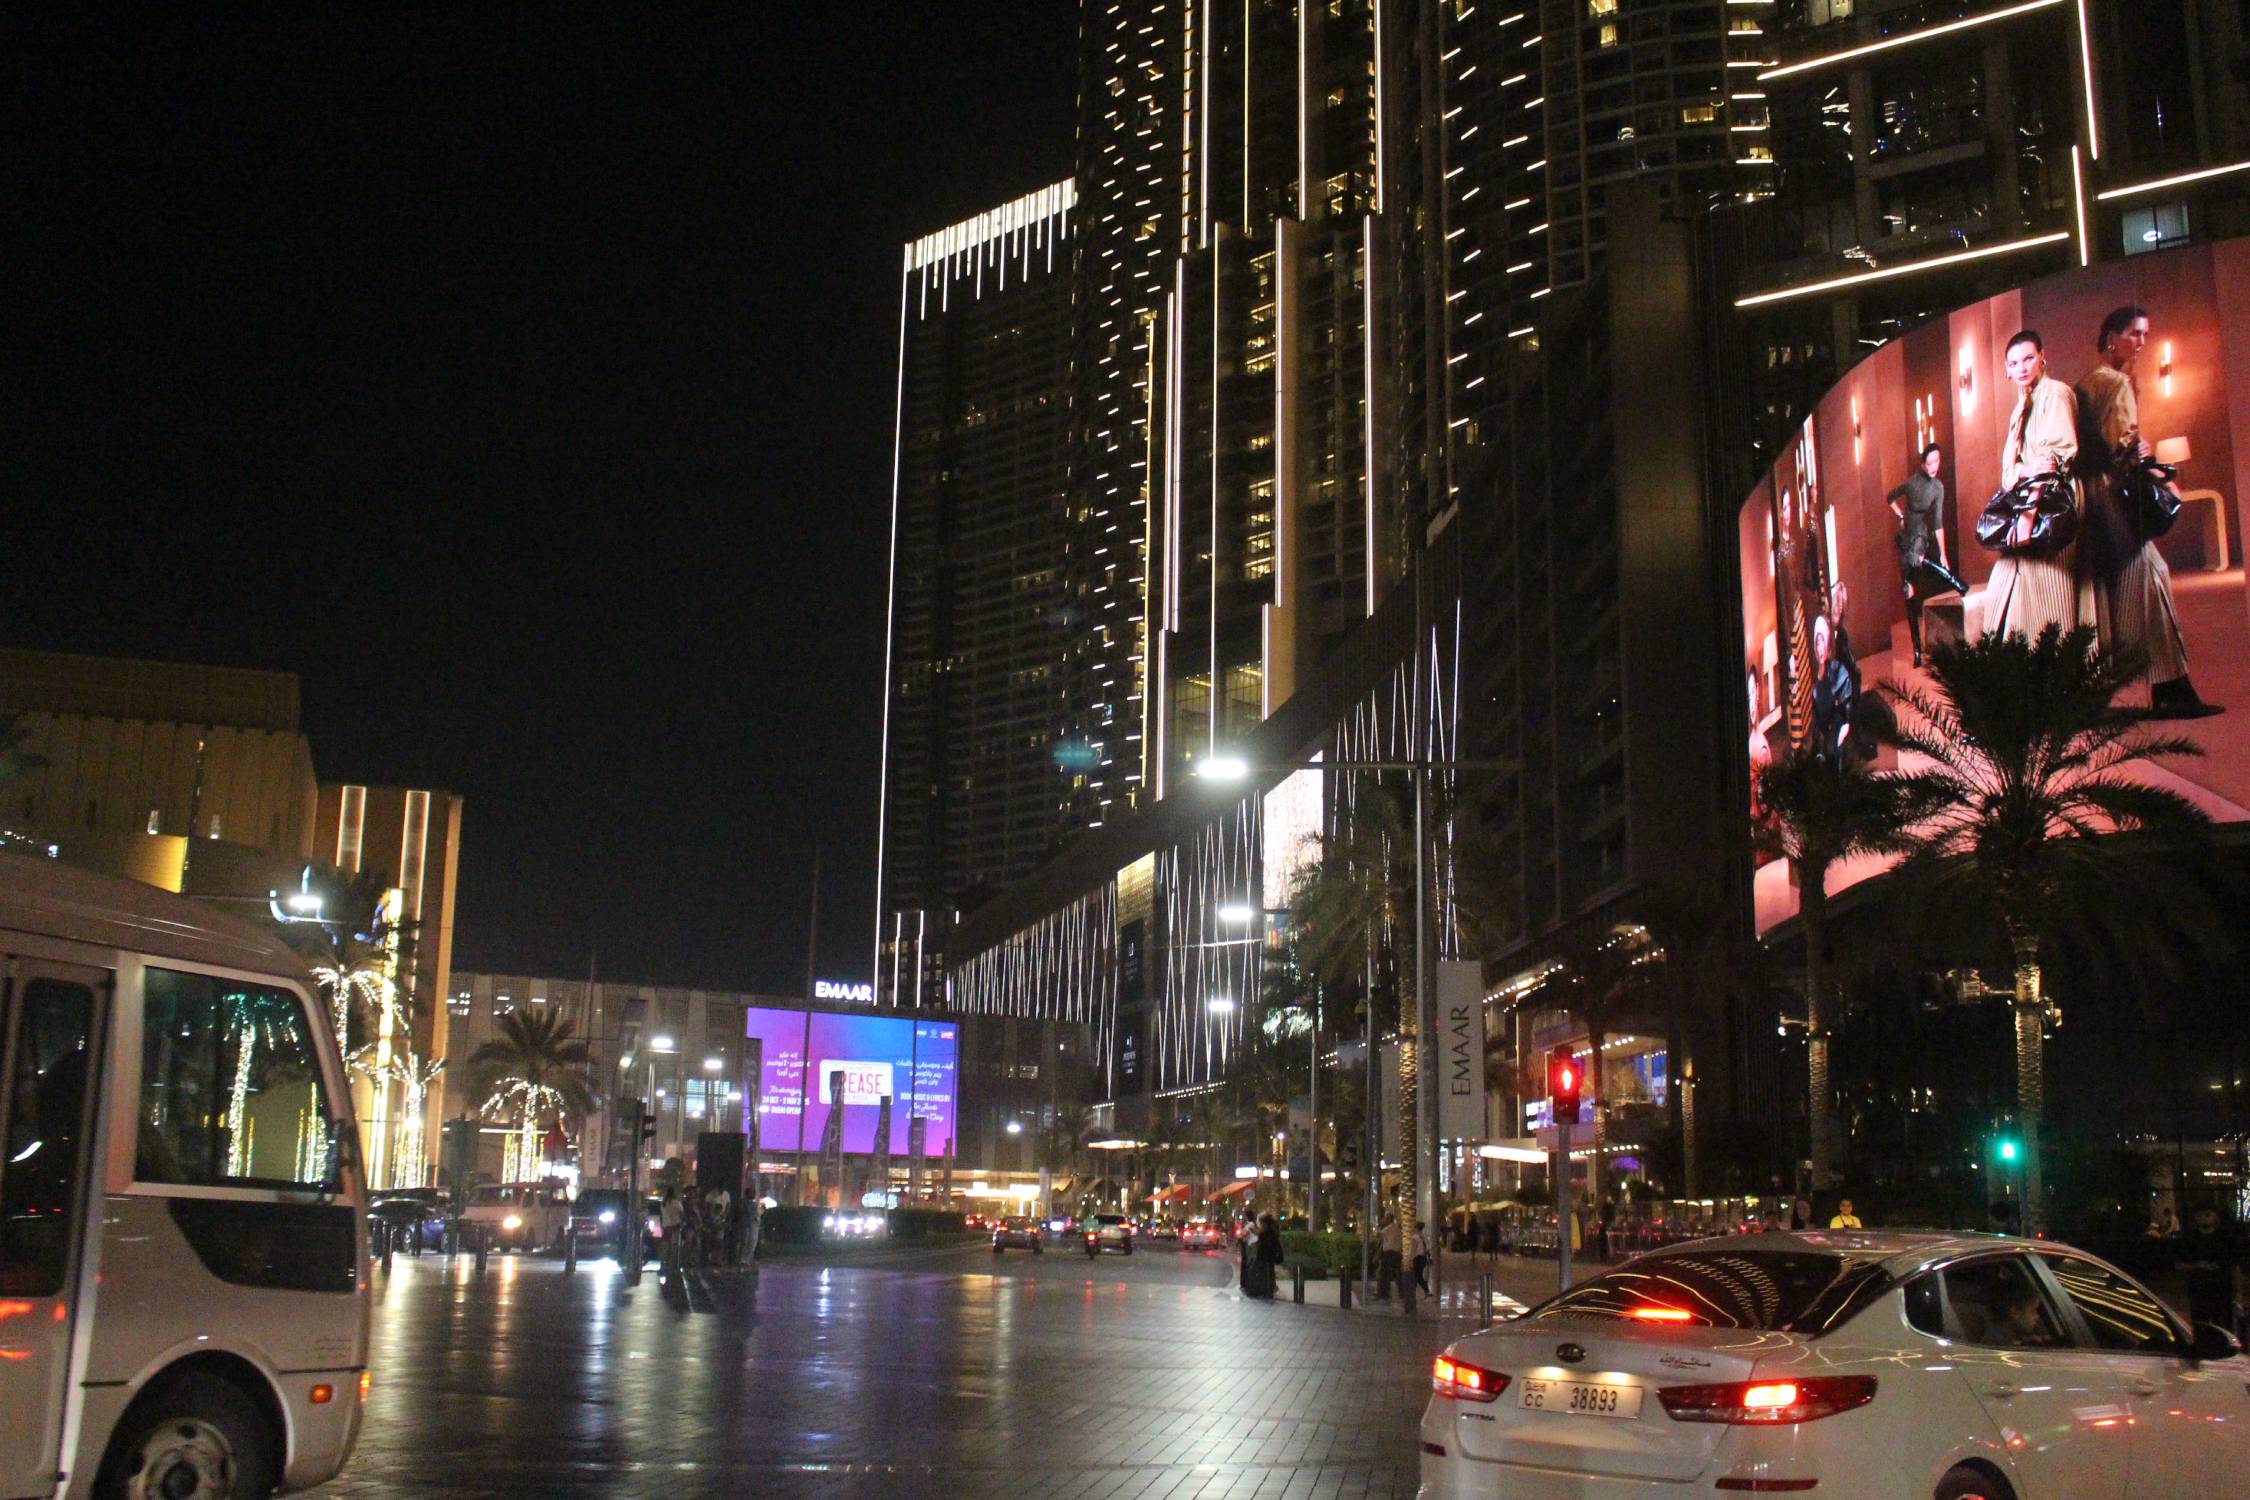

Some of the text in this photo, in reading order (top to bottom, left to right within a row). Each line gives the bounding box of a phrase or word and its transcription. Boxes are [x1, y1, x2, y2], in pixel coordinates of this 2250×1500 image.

[815, 980, 873, 1002] EMAAR
[1450, 1005, 1471, 1096] EMAAR
[1524, 1393, 1544, 1408] CC
[1570, 1386, 1618, 1412] 38893
